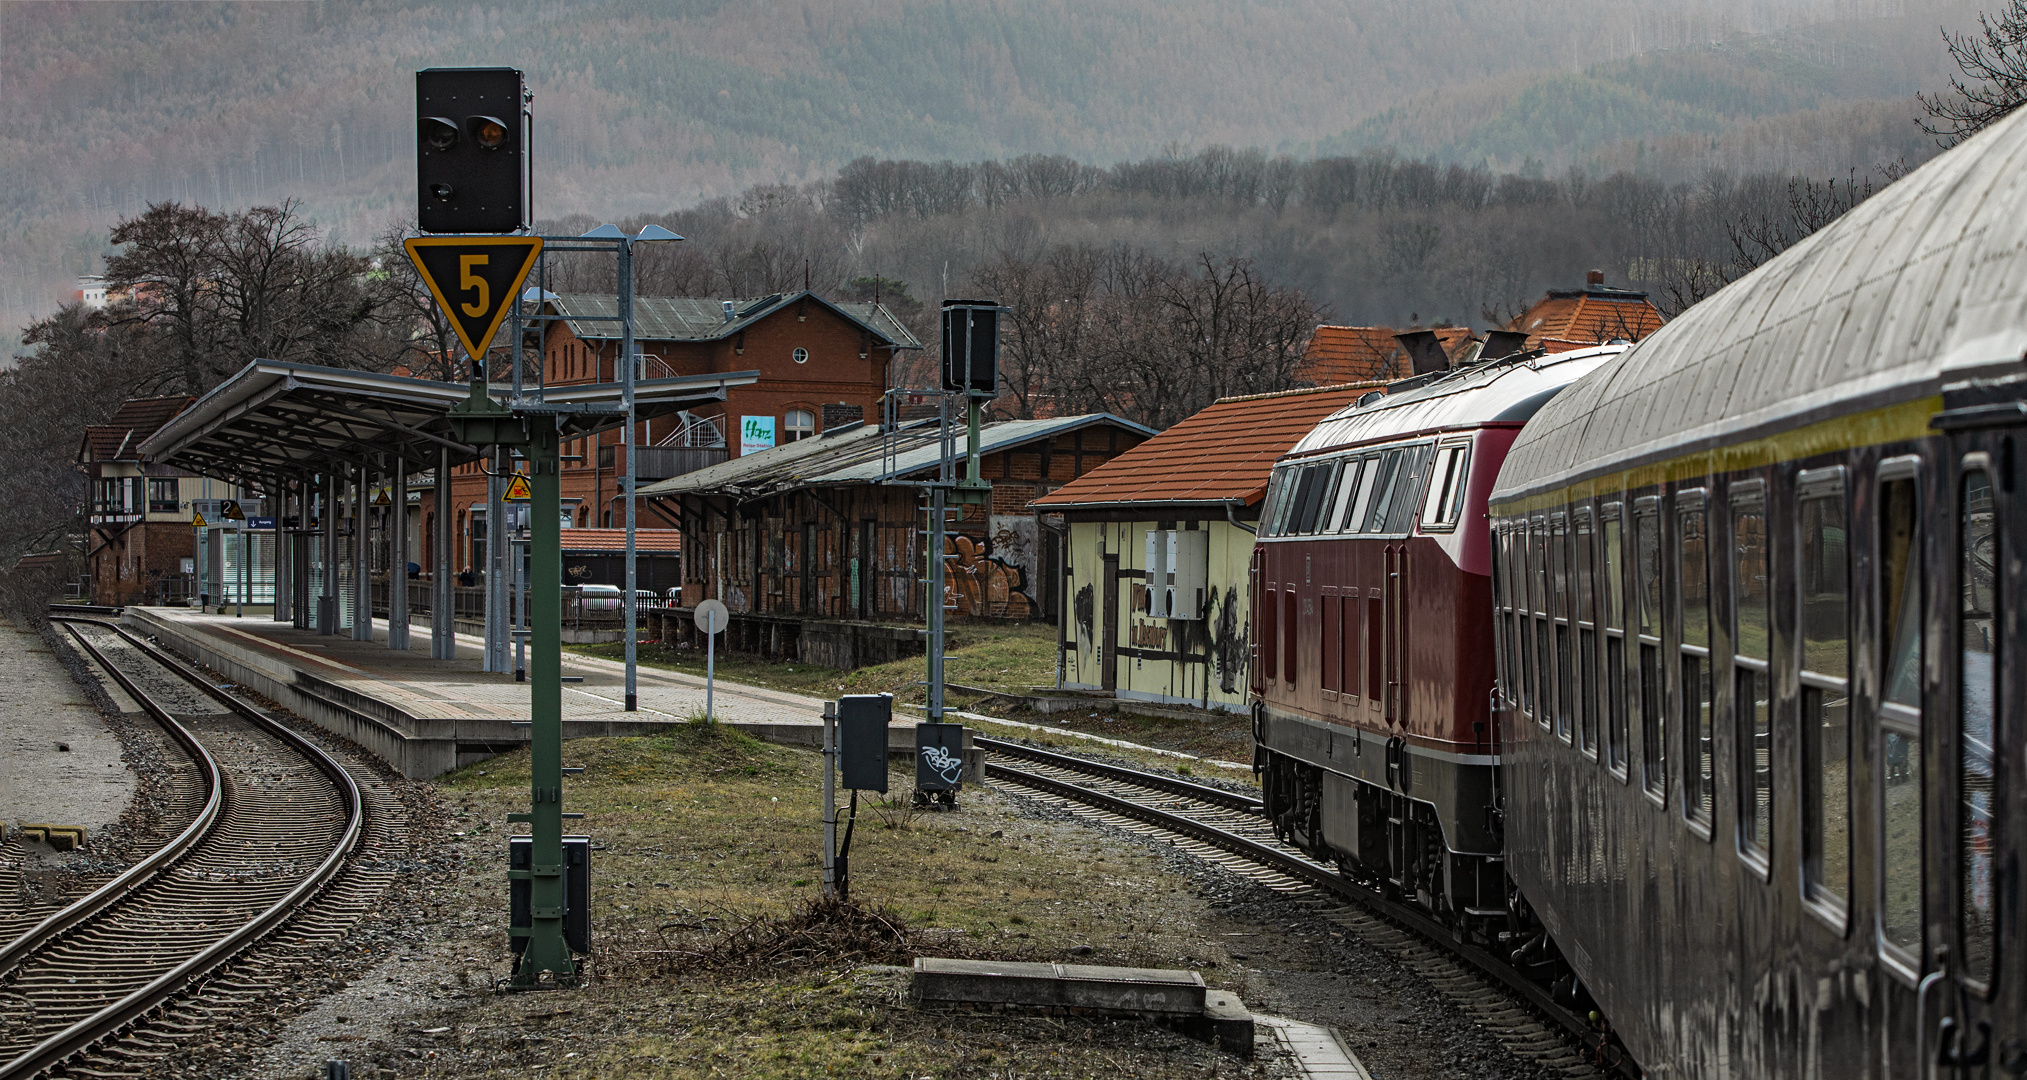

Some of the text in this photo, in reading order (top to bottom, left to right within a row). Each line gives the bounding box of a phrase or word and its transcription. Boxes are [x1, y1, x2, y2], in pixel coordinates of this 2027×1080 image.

[460, 254, 489, 318] 5
[745, 420, 772, 440] Harz
[223, 501, 232, 514] 2
